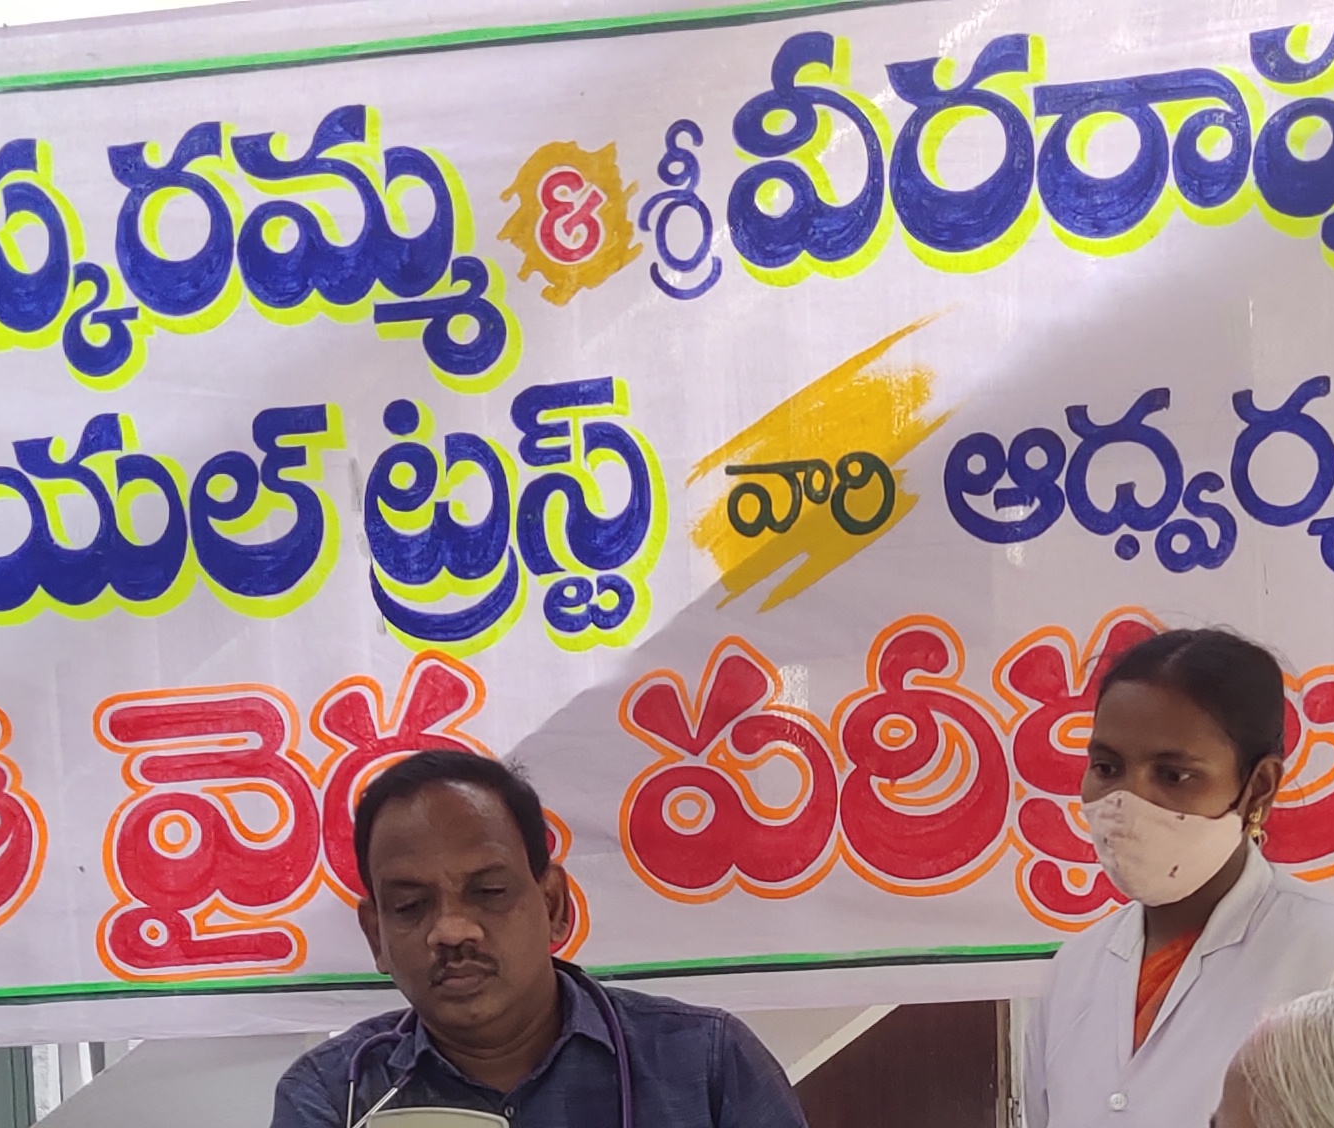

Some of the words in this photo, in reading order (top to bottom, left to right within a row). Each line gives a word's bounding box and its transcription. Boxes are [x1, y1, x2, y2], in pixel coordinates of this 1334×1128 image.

[641, 120, 725, 300] శ్రీ
[364, 376, 655, 643] ట్రస్ట్
[725, 452, 895, 537] వారి
